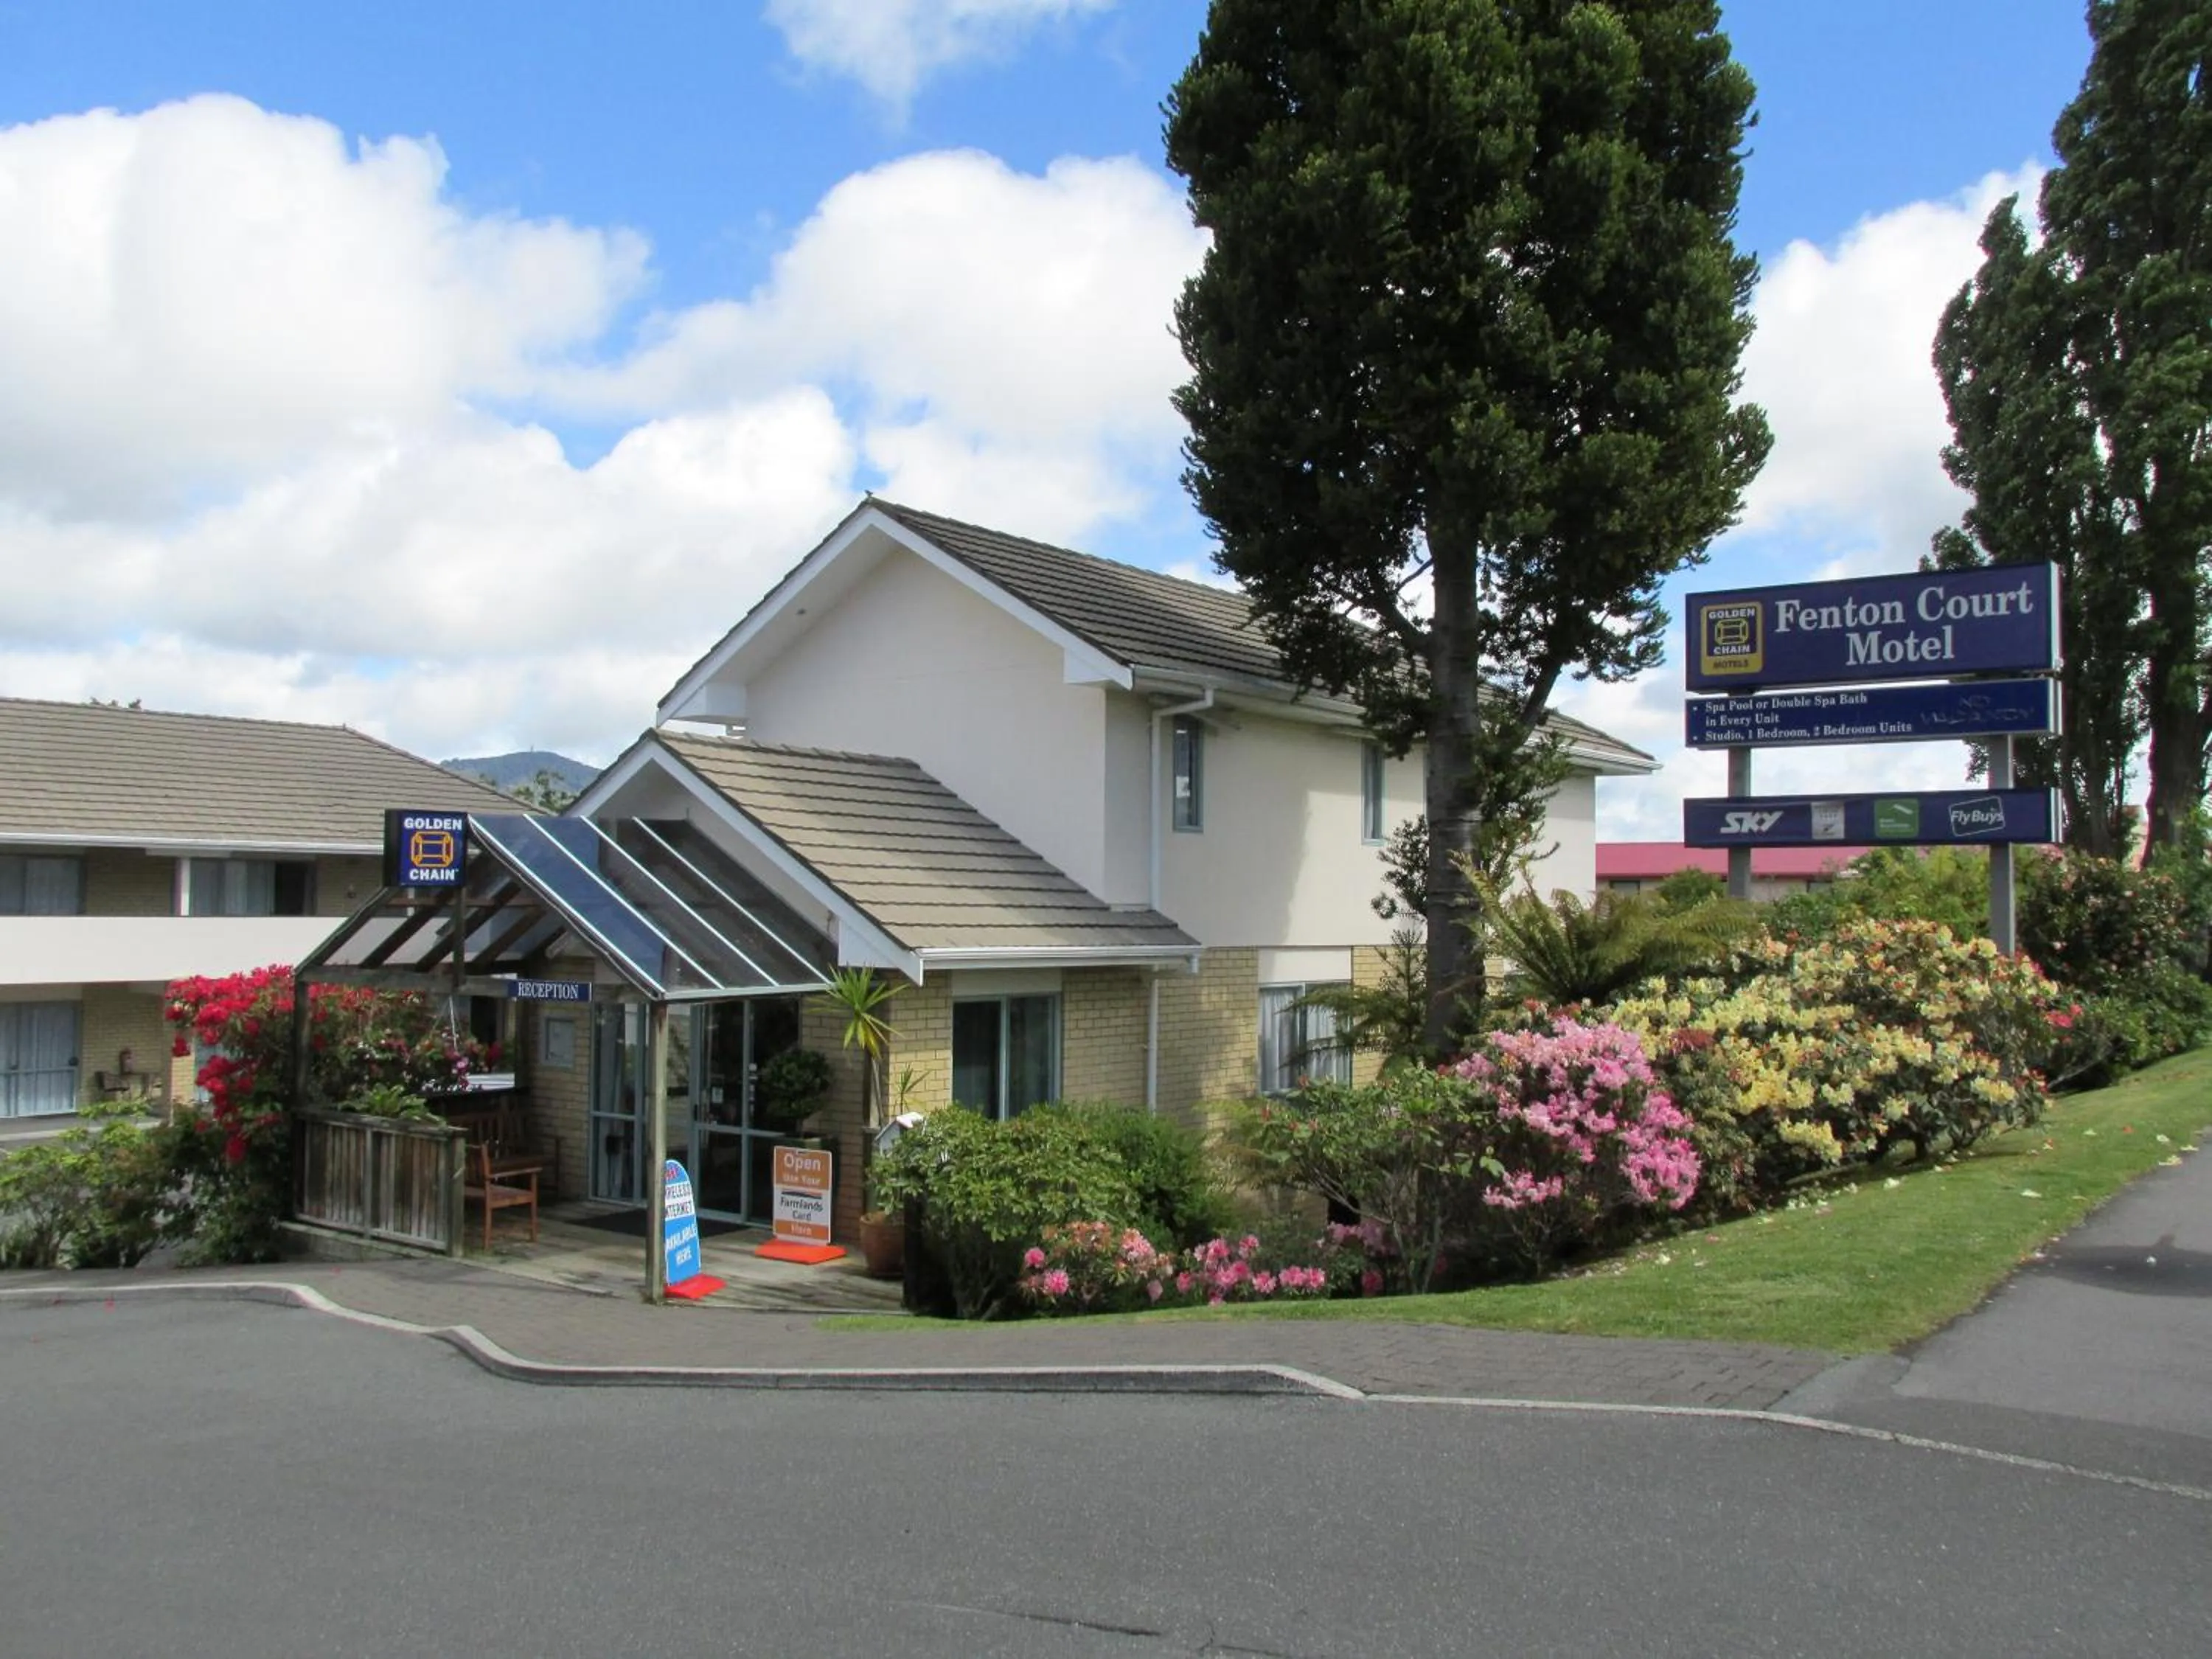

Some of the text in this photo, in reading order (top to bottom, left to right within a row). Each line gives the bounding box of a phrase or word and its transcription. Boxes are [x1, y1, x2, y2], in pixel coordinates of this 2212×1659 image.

[1708, 608, 1756, 620] GOLDEN
[1775, 581, 2033, 633] Fenton Court
[1713, 644, 1751, 655] CHAIN
[1845, 625, 1955, 666] Motel
[1713, 660, 1750, 669] MOTELS
[1705, 692, 1868, 714] Spa Pool or Double Spa Bath
[1705, 712, 1780, 727] in Every Unit
[1748, 730, 1753, 740] 1
[1813, 726, 1820, 737] 2
[1823, 723, 1877, 736] Bedroom
[1880, 721, 1913, 734] Units
[403, 817, 462, 831] GOLDEN
[1719, 810, 1784, 834] SKY
[409, 868, 455, 881] CHAIN
[518, 981, 579, 999] RECEPTION
[784, 1152, 821, 1172] Open
[780, 1196, 824, 1212] Farmlands
[793, 1211, 812, 1221] Card
